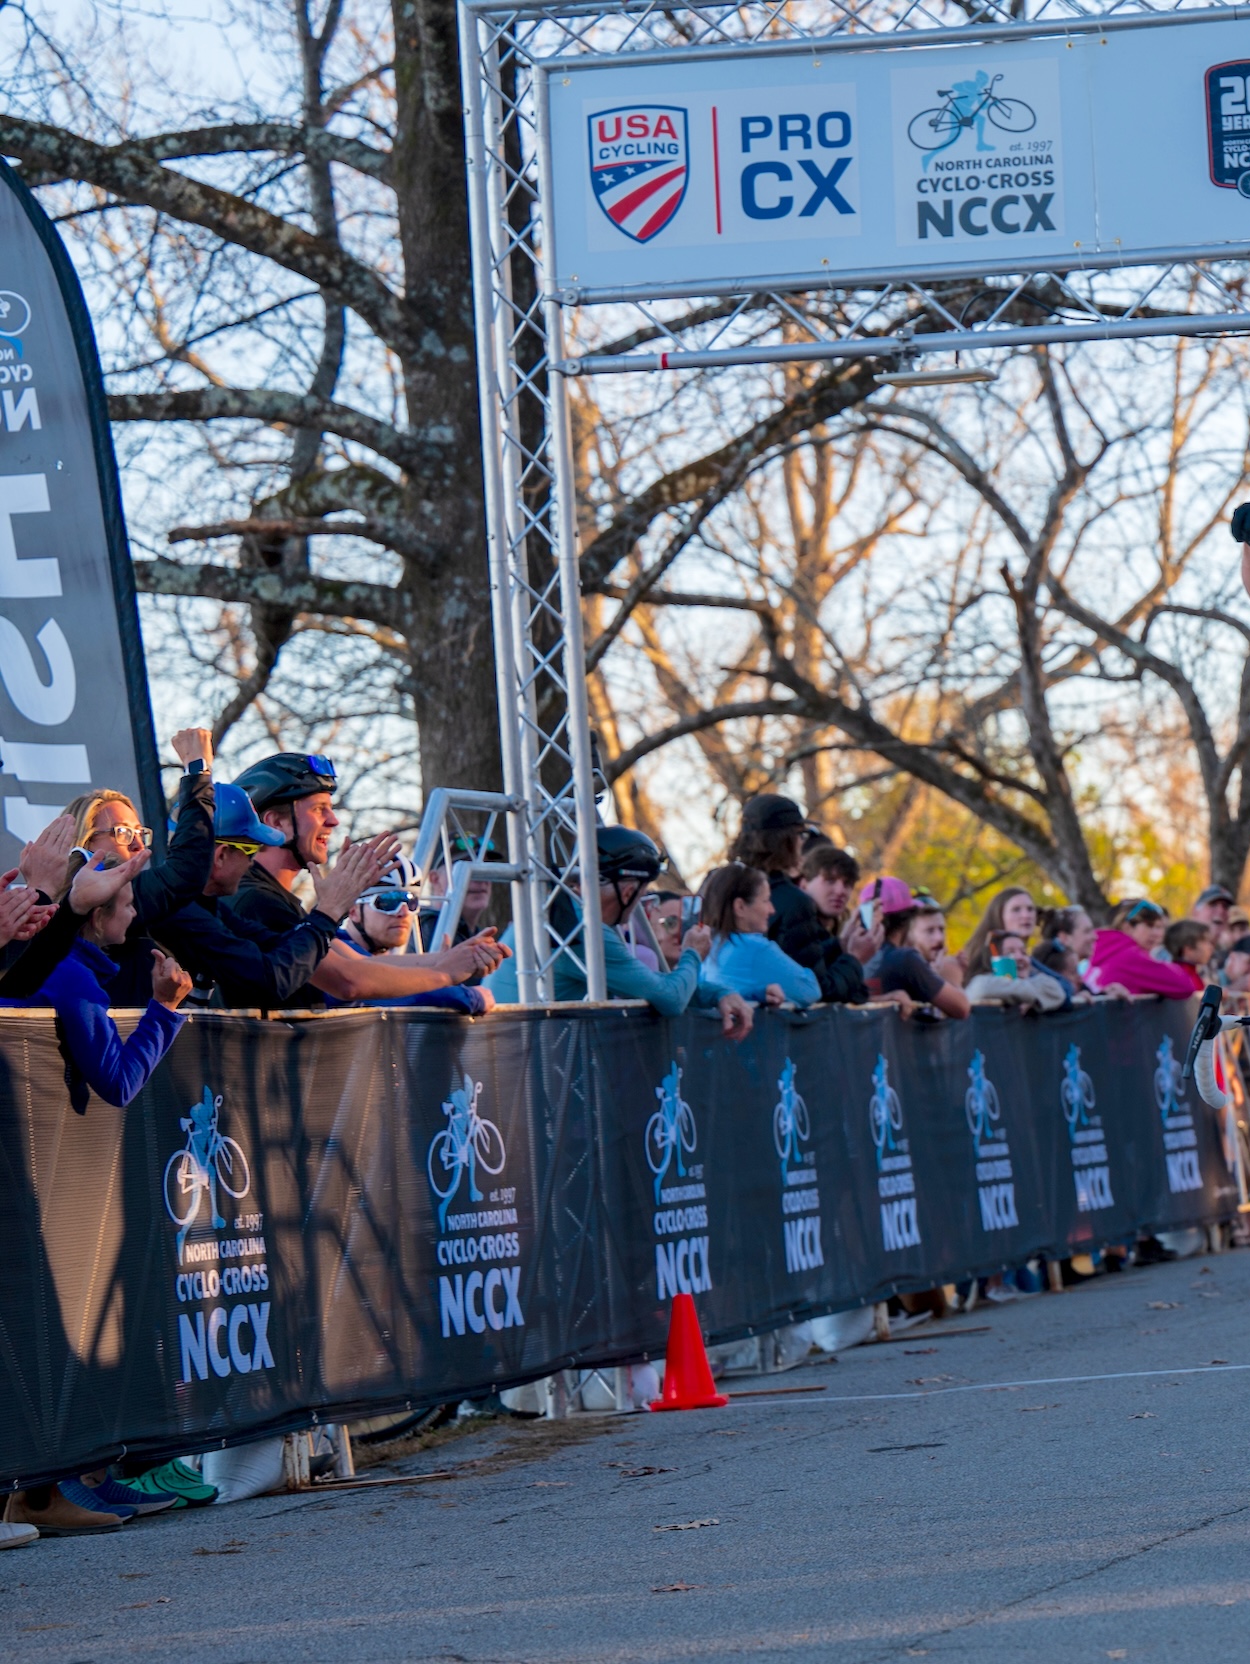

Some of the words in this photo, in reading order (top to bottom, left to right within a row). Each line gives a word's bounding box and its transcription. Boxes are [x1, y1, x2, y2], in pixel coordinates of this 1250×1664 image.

[598, 114, 679, 143] USA
[740, 110, 852, 153] PRO
[1027, 140, 1053, 153] 1997
[598, 142, 680, 160] CYCLING
[934, 158, 982, 172] NORTH
[985, 154, 1054, 168] CAROLINA
[740, 157, 857, 220] CX
[917, 192, 1057, 240] NCCX
[446, 1212, 478, 1231] NORTH
[478, 1207, 518, 1228] CAROLINA
[186, 1241, 219, 1264] NORTH
[219, 1236, 267, 1259] CAROLINA
[784, 1215, 825, 1274] NCCX
[655, 1235, 713, 1300] NCCX
[439, 1265, 526, 1338] NCCX
[178, 1301, 276, 1384] NCCX
